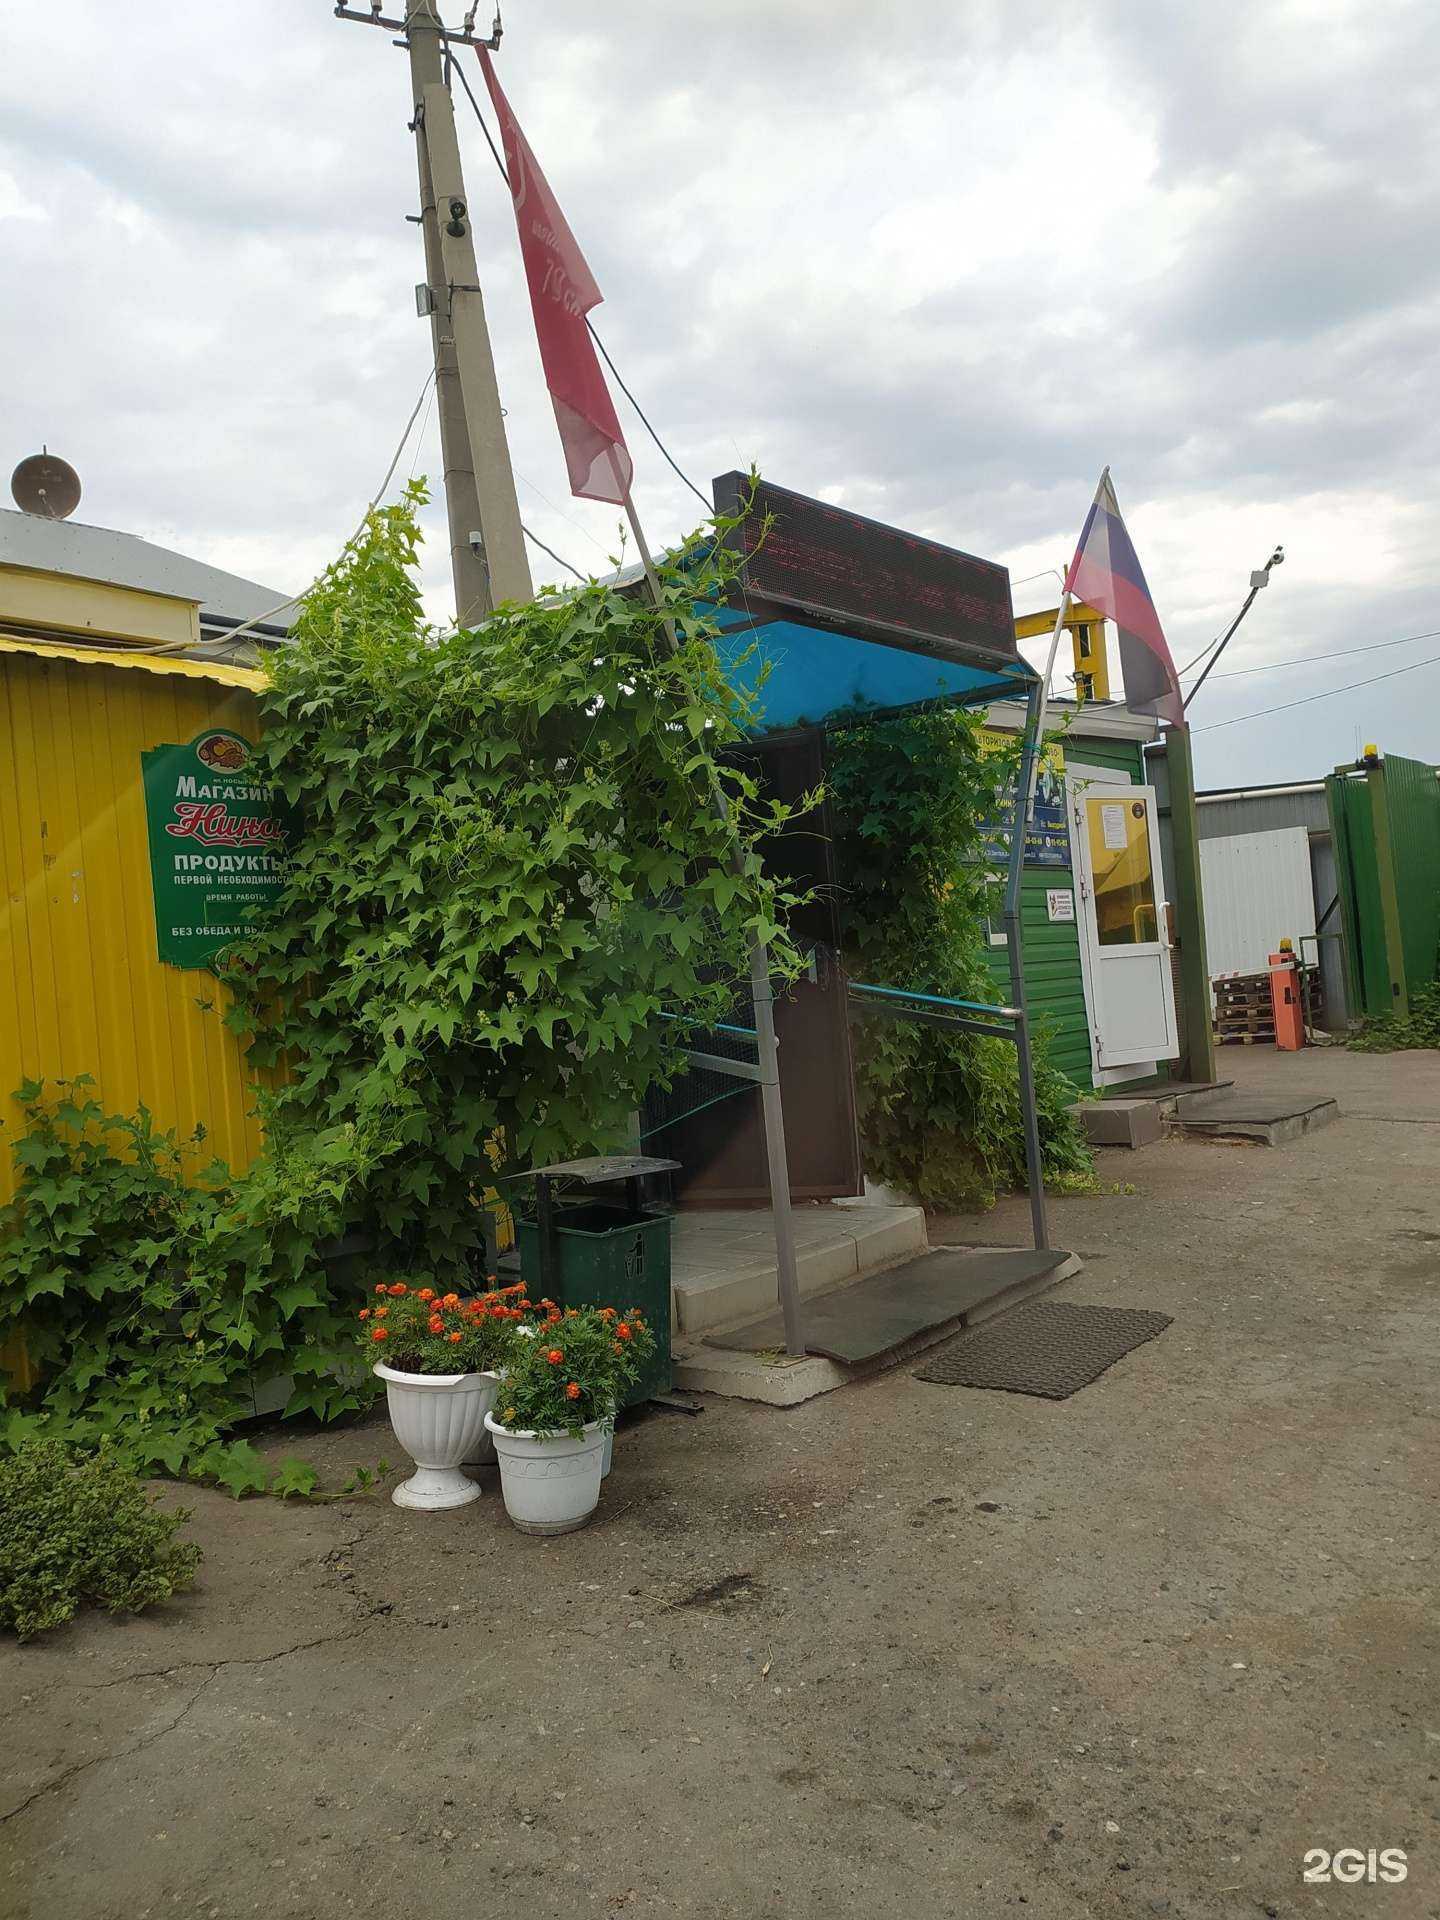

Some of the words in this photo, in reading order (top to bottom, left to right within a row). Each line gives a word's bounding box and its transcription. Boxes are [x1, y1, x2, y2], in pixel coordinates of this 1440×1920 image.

[174, 855, 288, 873] ПРОДУКТЫ
[174, 873, 213, 885] ПЕРВОЙ
[236, 893, 266, 901] РАБОТЫ
[171, 927, 193, 937] БЕЗ
[195, 926, 231, 936] ОБЕДА
[233, 926, 241, 935] И
